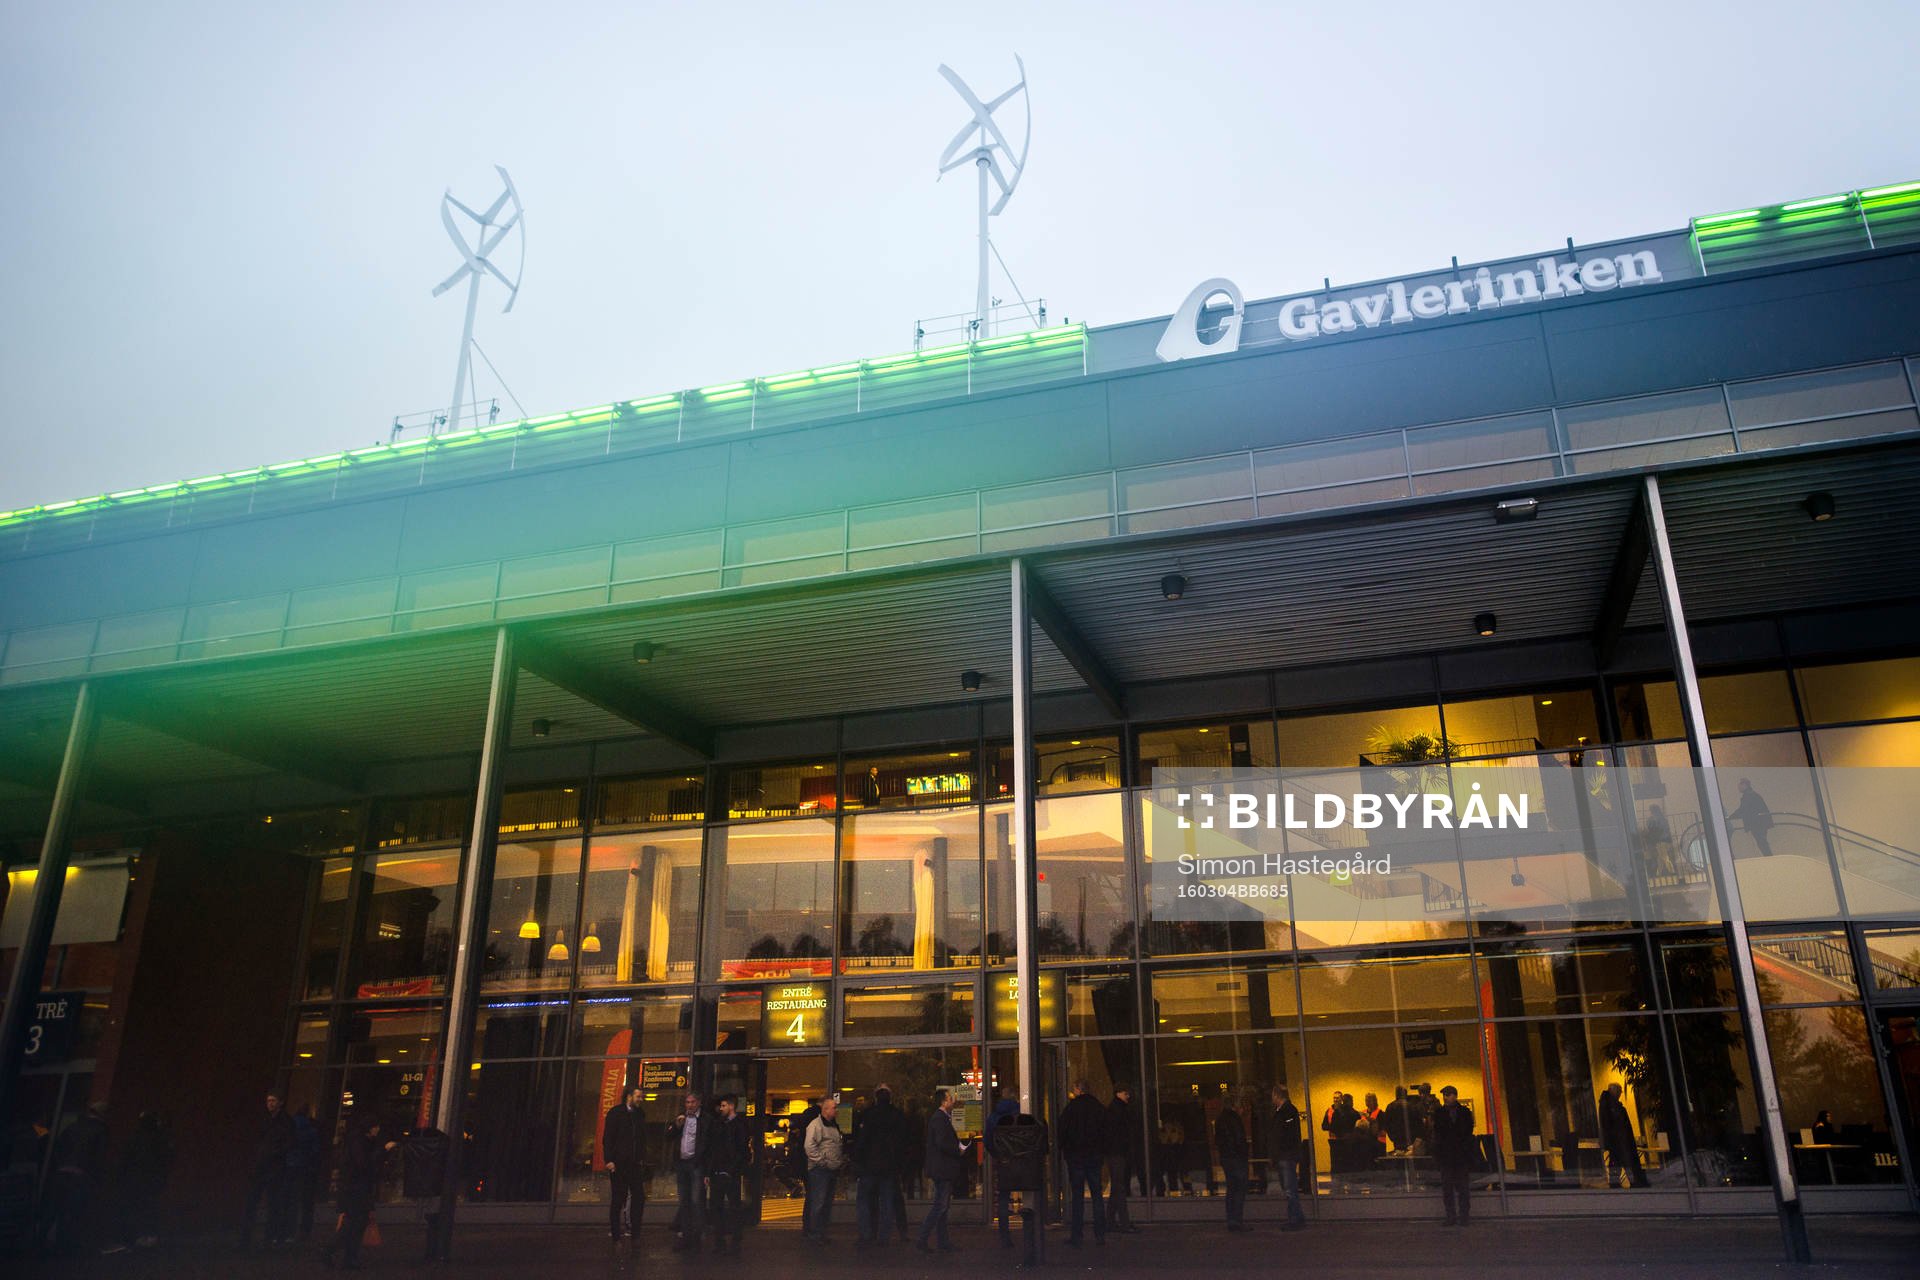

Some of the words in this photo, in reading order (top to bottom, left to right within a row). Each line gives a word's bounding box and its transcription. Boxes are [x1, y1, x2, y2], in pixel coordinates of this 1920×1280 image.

[1277, 247, 1664, 341] Gavlerinken
[782, 985, 812, 998] ENTRÉ
[36, 998, 68, 1020] TRÉ
[767, 999, 827, 1011] RESTAURANG
[23, 1025, 44, 1055] 3
[785, 1013, 806, 1043] 4
